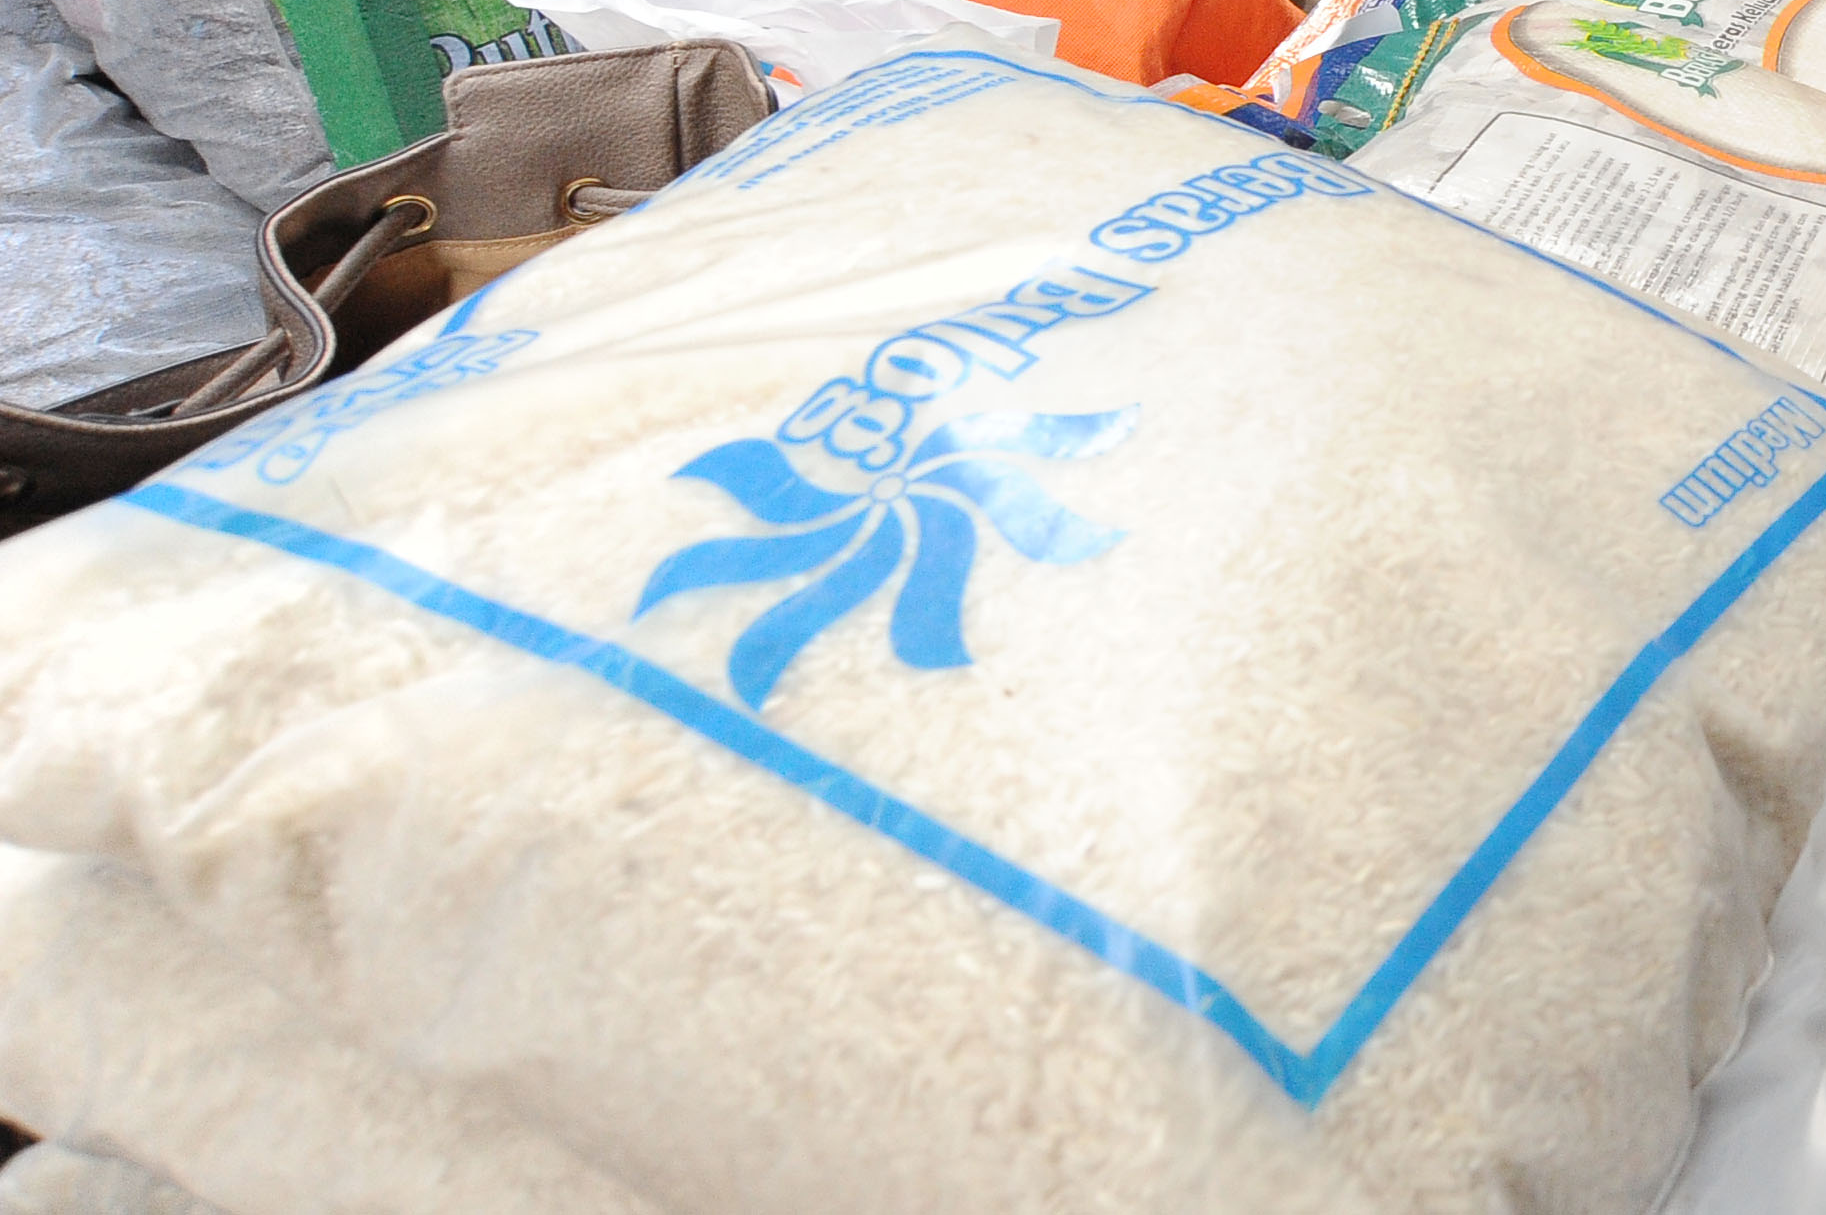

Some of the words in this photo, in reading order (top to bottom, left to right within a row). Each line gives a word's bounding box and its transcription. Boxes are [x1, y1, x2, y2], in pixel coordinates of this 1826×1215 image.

[1089, 151, 1375, 263] Beras
[776, 265, 1159, 473] Bulog
[1660, 396, 1826, 527] Medium
